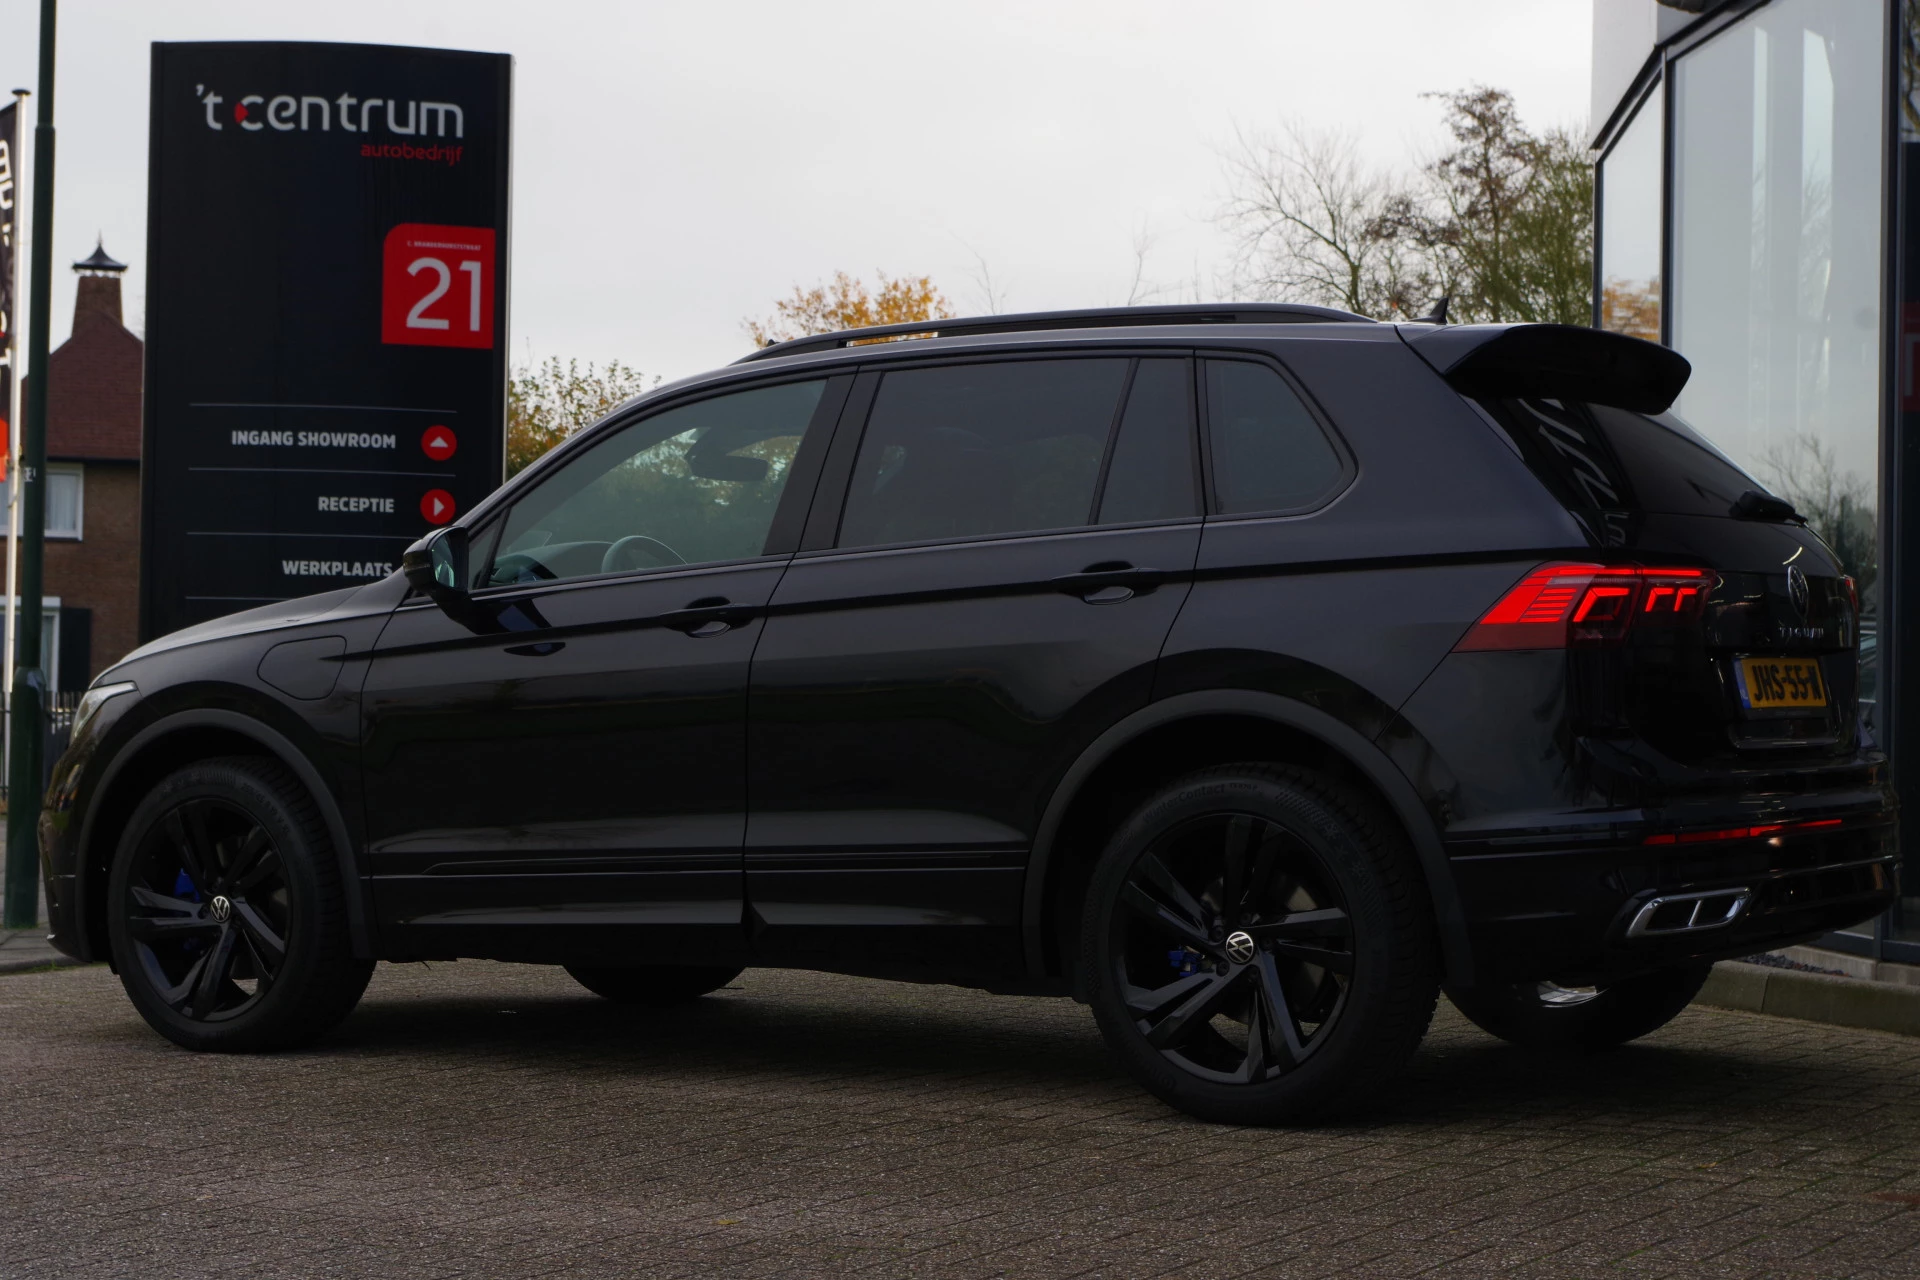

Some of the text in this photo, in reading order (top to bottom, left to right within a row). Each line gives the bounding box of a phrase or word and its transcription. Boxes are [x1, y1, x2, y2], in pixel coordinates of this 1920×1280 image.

[234, 91, 464, 138] centrum
[360, 142, 463, 166] autobedrijf
[406, 257, 483, 332] 21
[231, 430, 396, 449] INGANG SHOWROOM
[318, 496, 395, 513] RECEPTIE
[282, 560, 393, 577] WERKPLAATS
[1752, 664, 1823, 702] JHS-55-N
